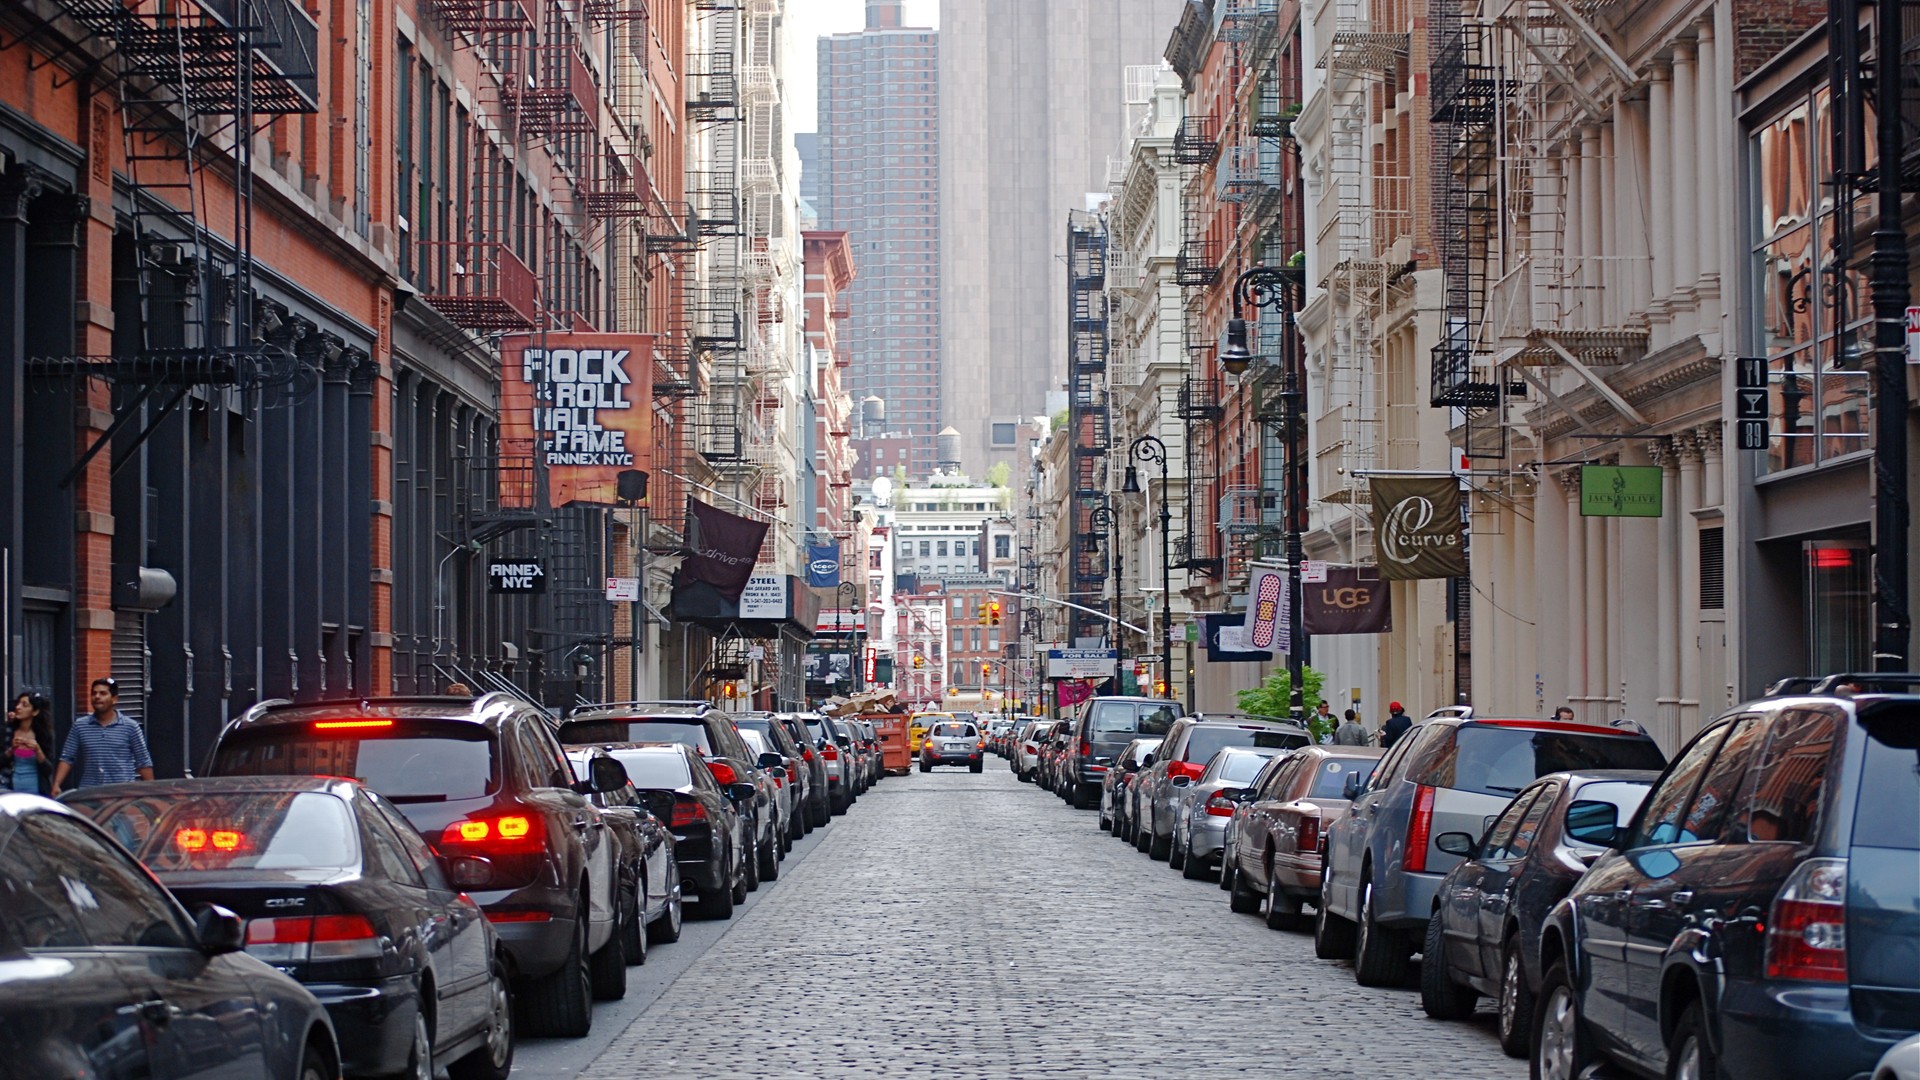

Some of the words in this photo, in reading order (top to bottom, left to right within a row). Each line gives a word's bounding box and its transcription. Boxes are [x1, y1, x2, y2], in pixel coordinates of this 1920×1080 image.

[523, 349, 631, 384] ROCK
[556, 383, 631, 408] ROLL
[555, 431, 625, 452] FAME
[1745, 422, 1762, 448] 89
[547, 452, 600, 465] ANNEX
[603, 453, 633, 466] NYC
[1588, 494, 1613, 503] JACK
[1623, 494, 1656, 504] OLIVE
[1398, 534, 1457, 546] curve
[706, 548, 738, 566] drive
[490, 564, 544, 576] ANNEX
[502, 576, 533, 589] NYC
[1322, 587, 1371, 609] UGG
